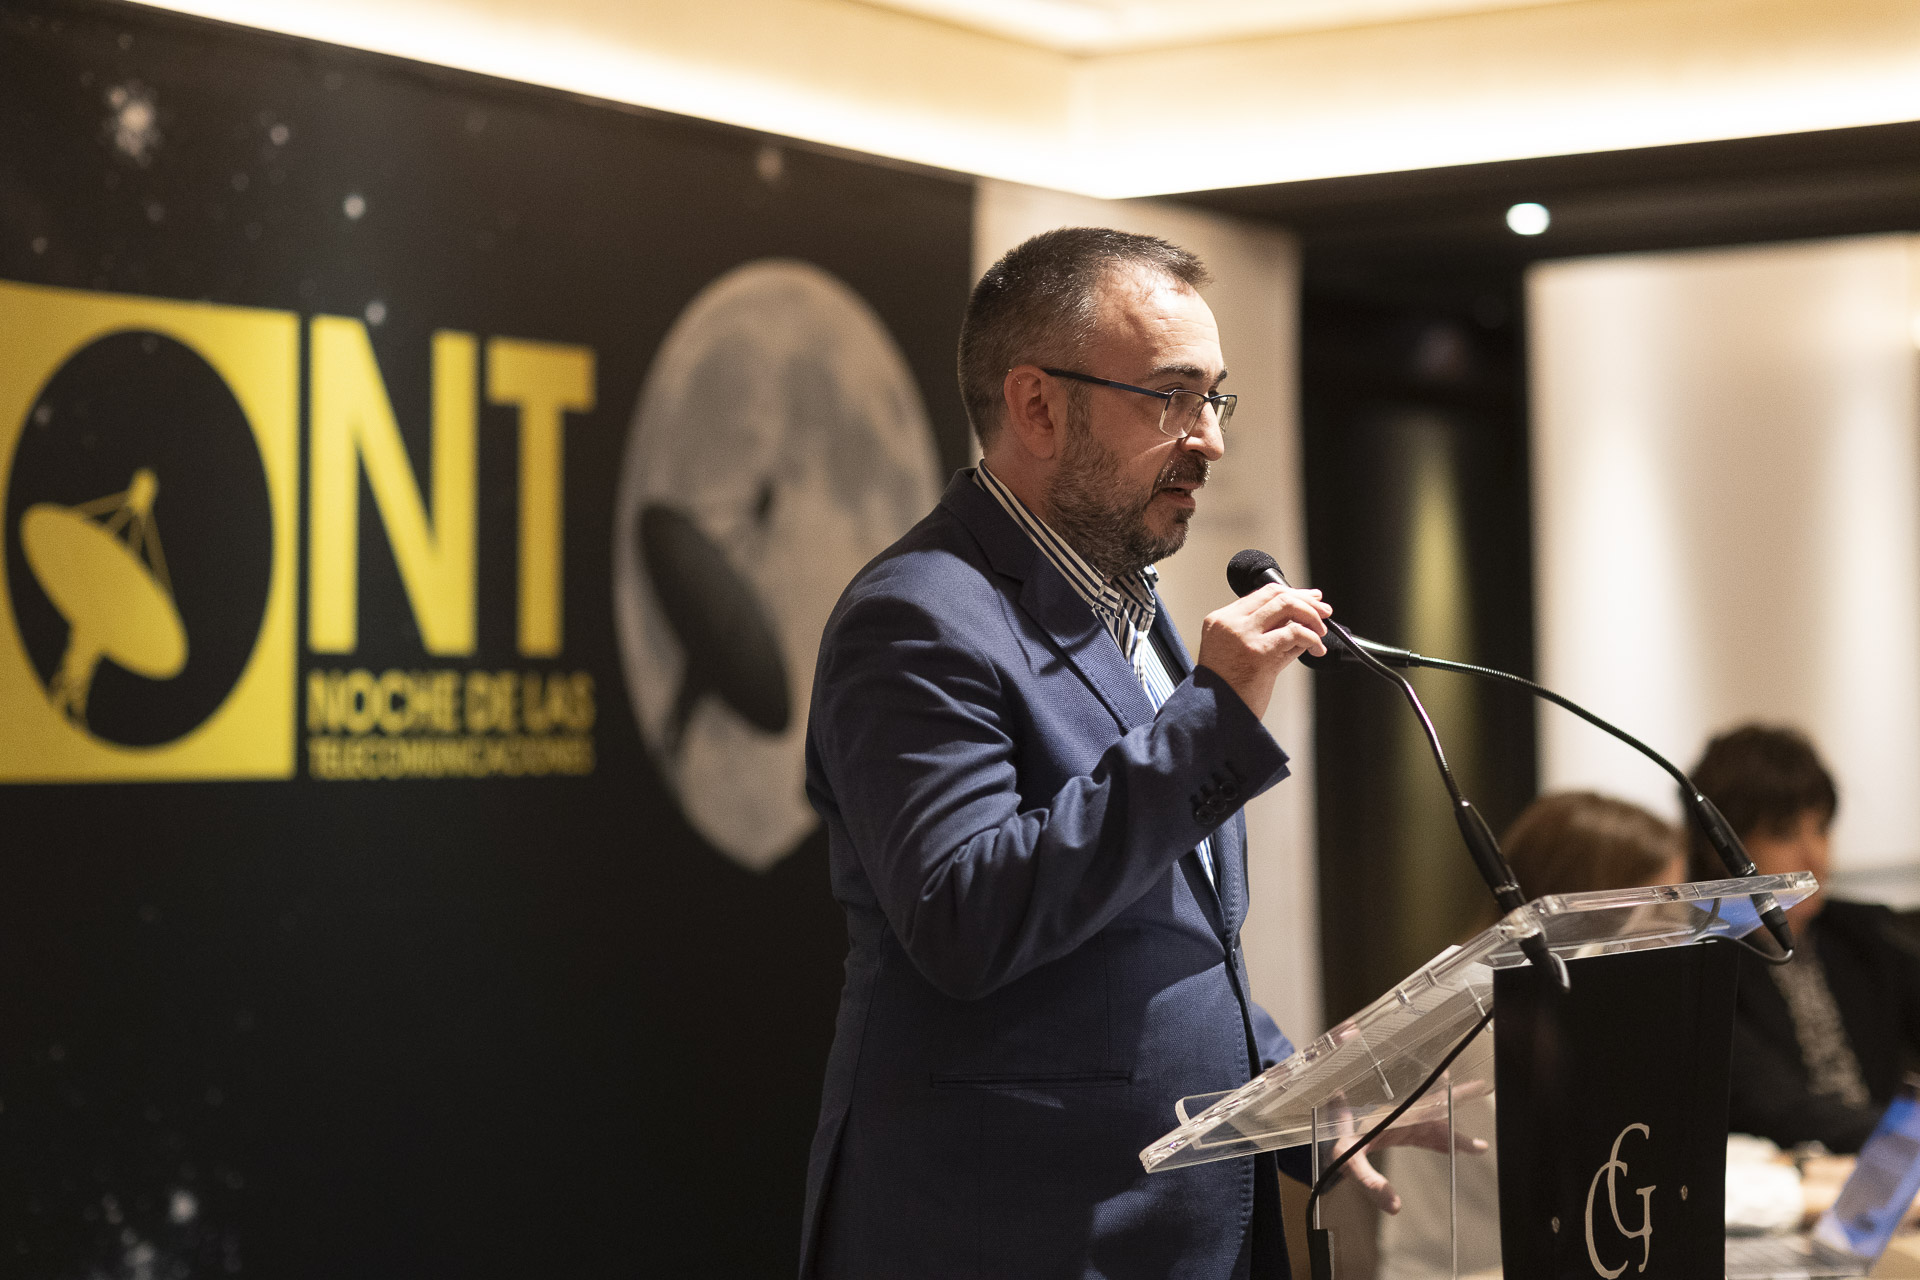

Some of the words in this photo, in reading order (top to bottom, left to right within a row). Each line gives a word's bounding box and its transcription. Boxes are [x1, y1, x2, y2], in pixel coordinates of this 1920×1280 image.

[308, 671, 460, 732] NOCHE
[465, 670, 518, 731] DE
[521, 672, 596, 729] LAS
